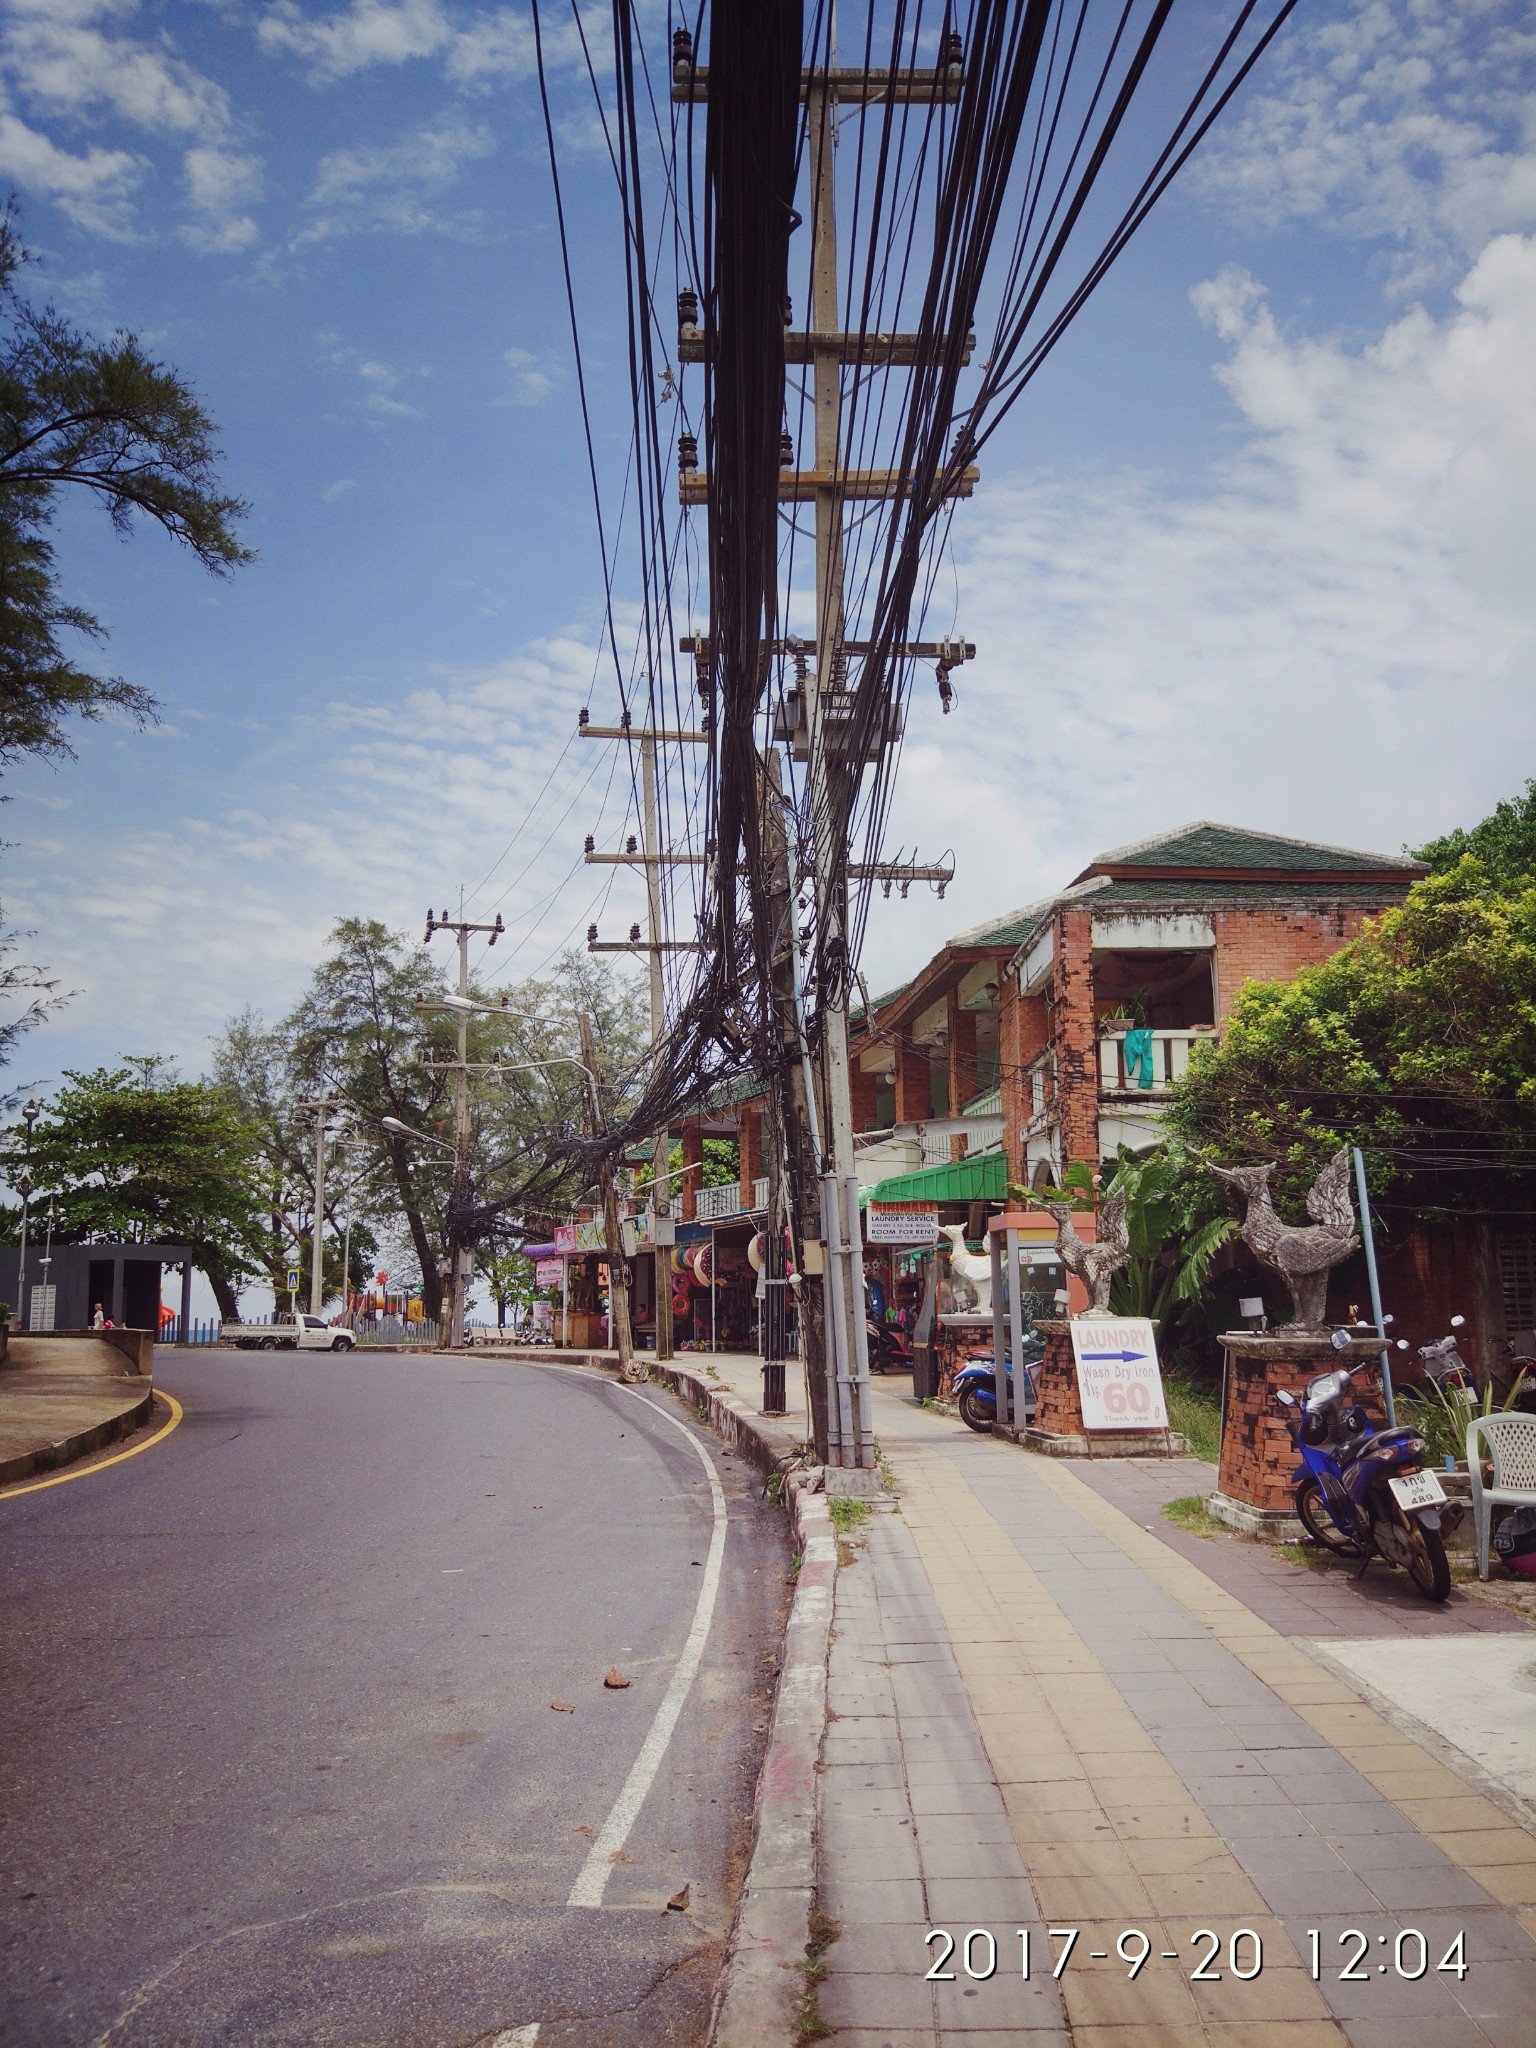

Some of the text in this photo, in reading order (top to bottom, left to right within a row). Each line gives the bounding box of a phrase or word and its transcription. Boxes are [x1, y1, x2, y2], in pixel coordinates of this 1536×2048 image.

[1077, 1329, 1147, 1348] LAUNDRY
[1083, 1366, 1155, 1380] Wash Dry Iron
[1103, 1382, 1151, 1413] 60
[1412, 1494, 1434, 1504] 489
